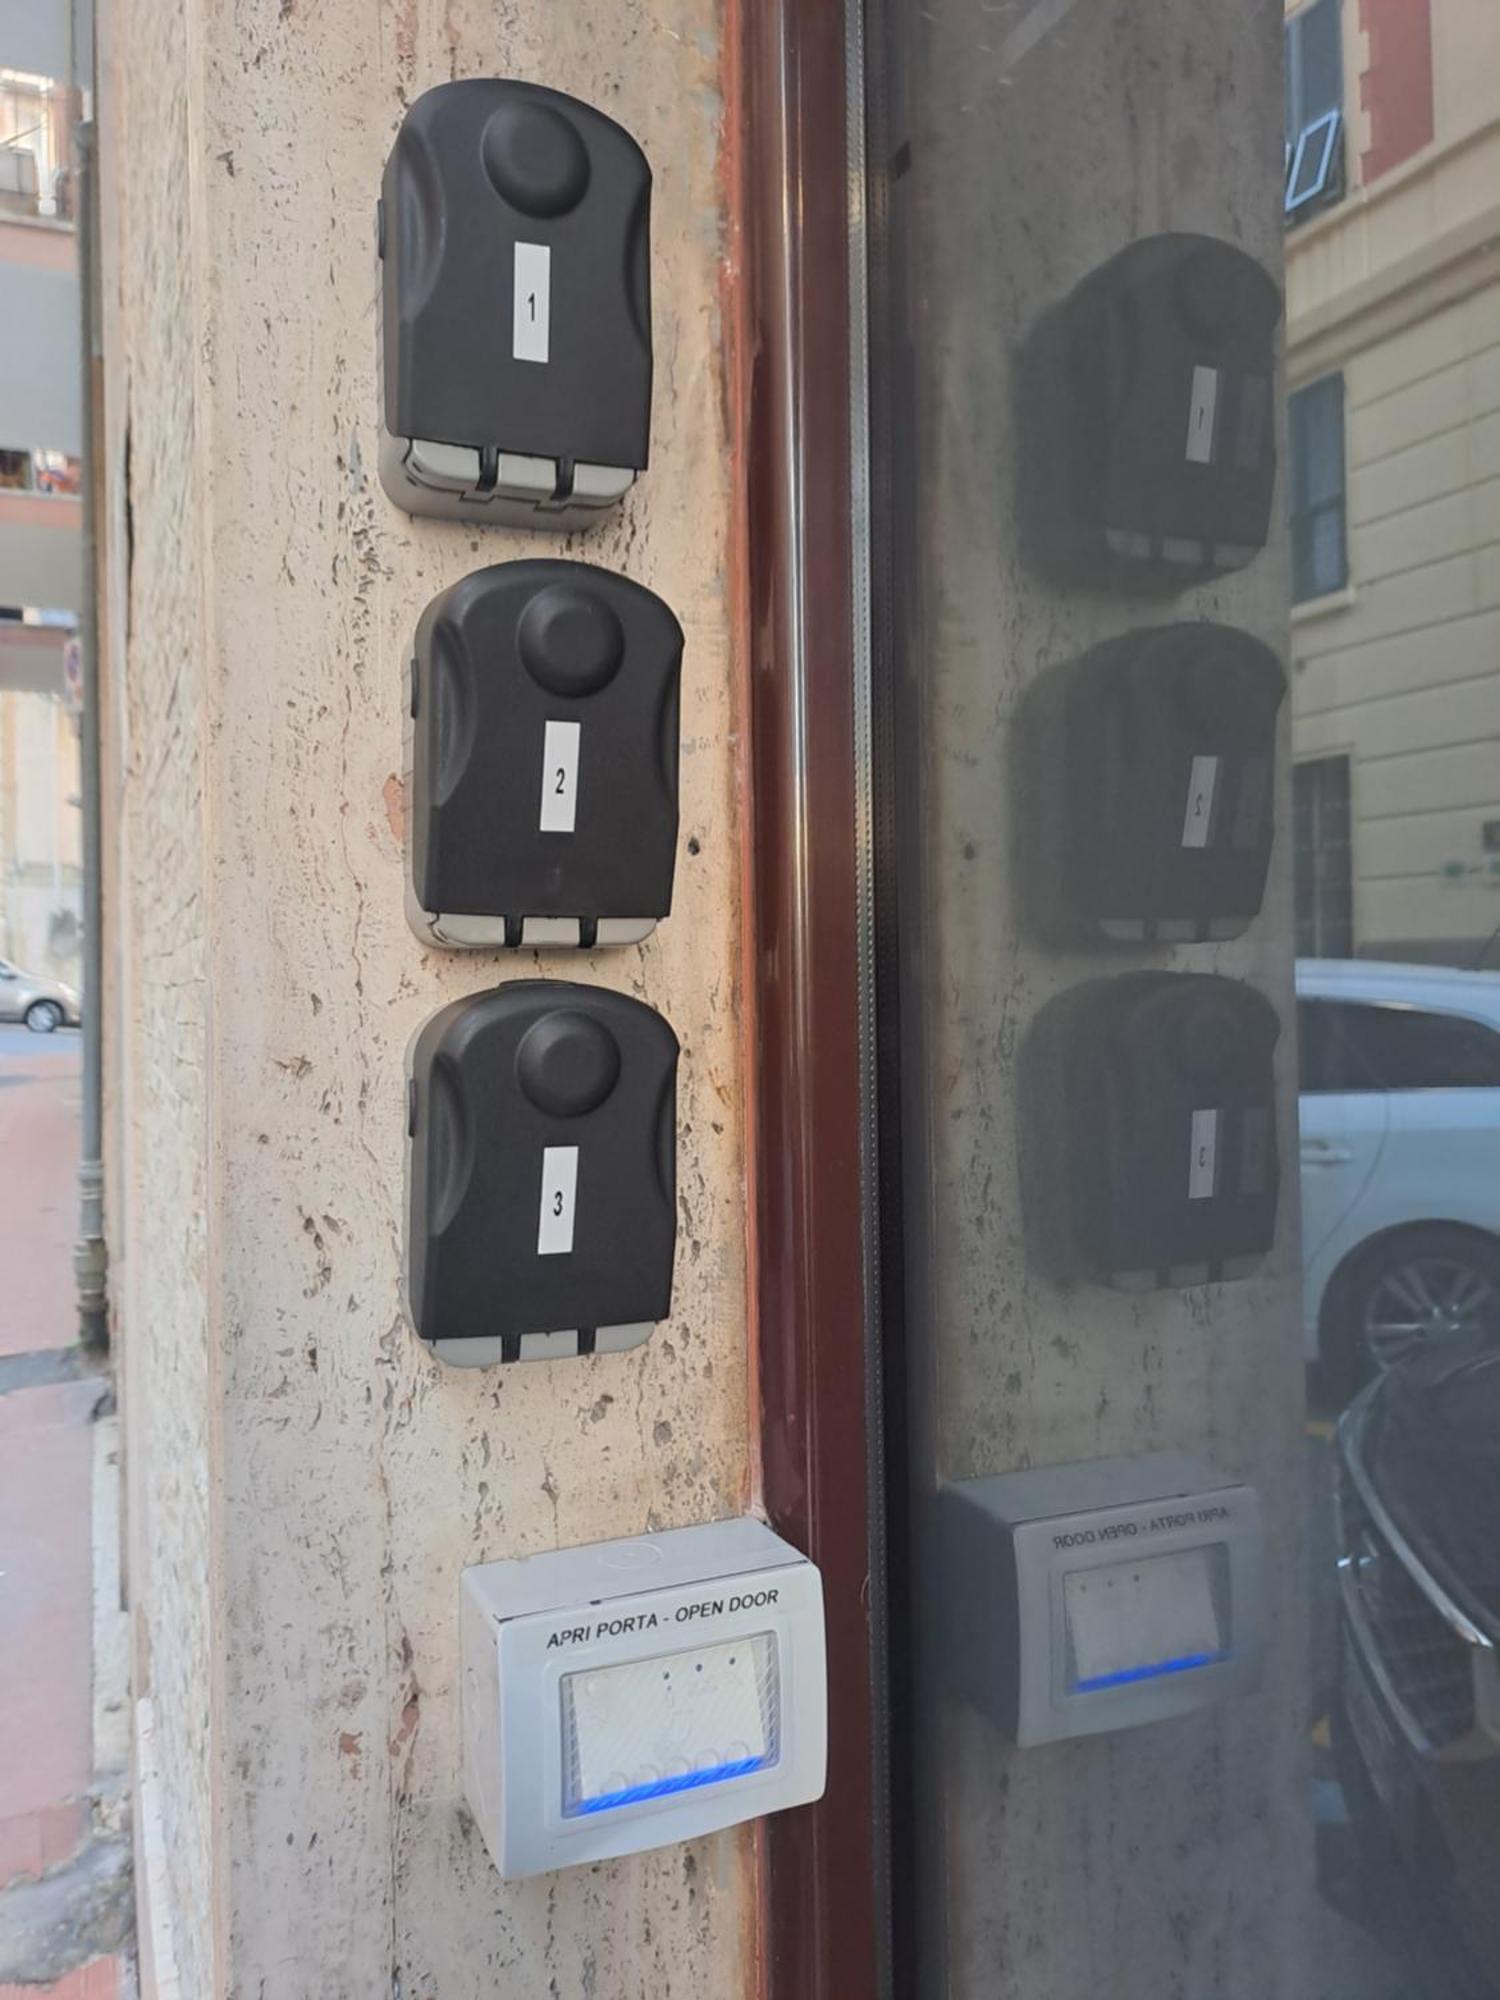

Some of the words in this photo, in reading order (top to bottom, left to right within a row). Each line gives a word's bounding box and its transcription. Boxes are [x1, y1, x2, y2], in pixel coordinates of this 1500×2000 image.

[528, 292, 535, 322] 1
[555, 767, 566, 795] 2
[553, 1190, 563, 1216] 3
[546, 1627, 591, 1649] APRI
[595, 1612, 659, 1639] PORTA
[675, 1599, 724, 1623] OPEN
[728, 1588, 779, 1612] DOOR
